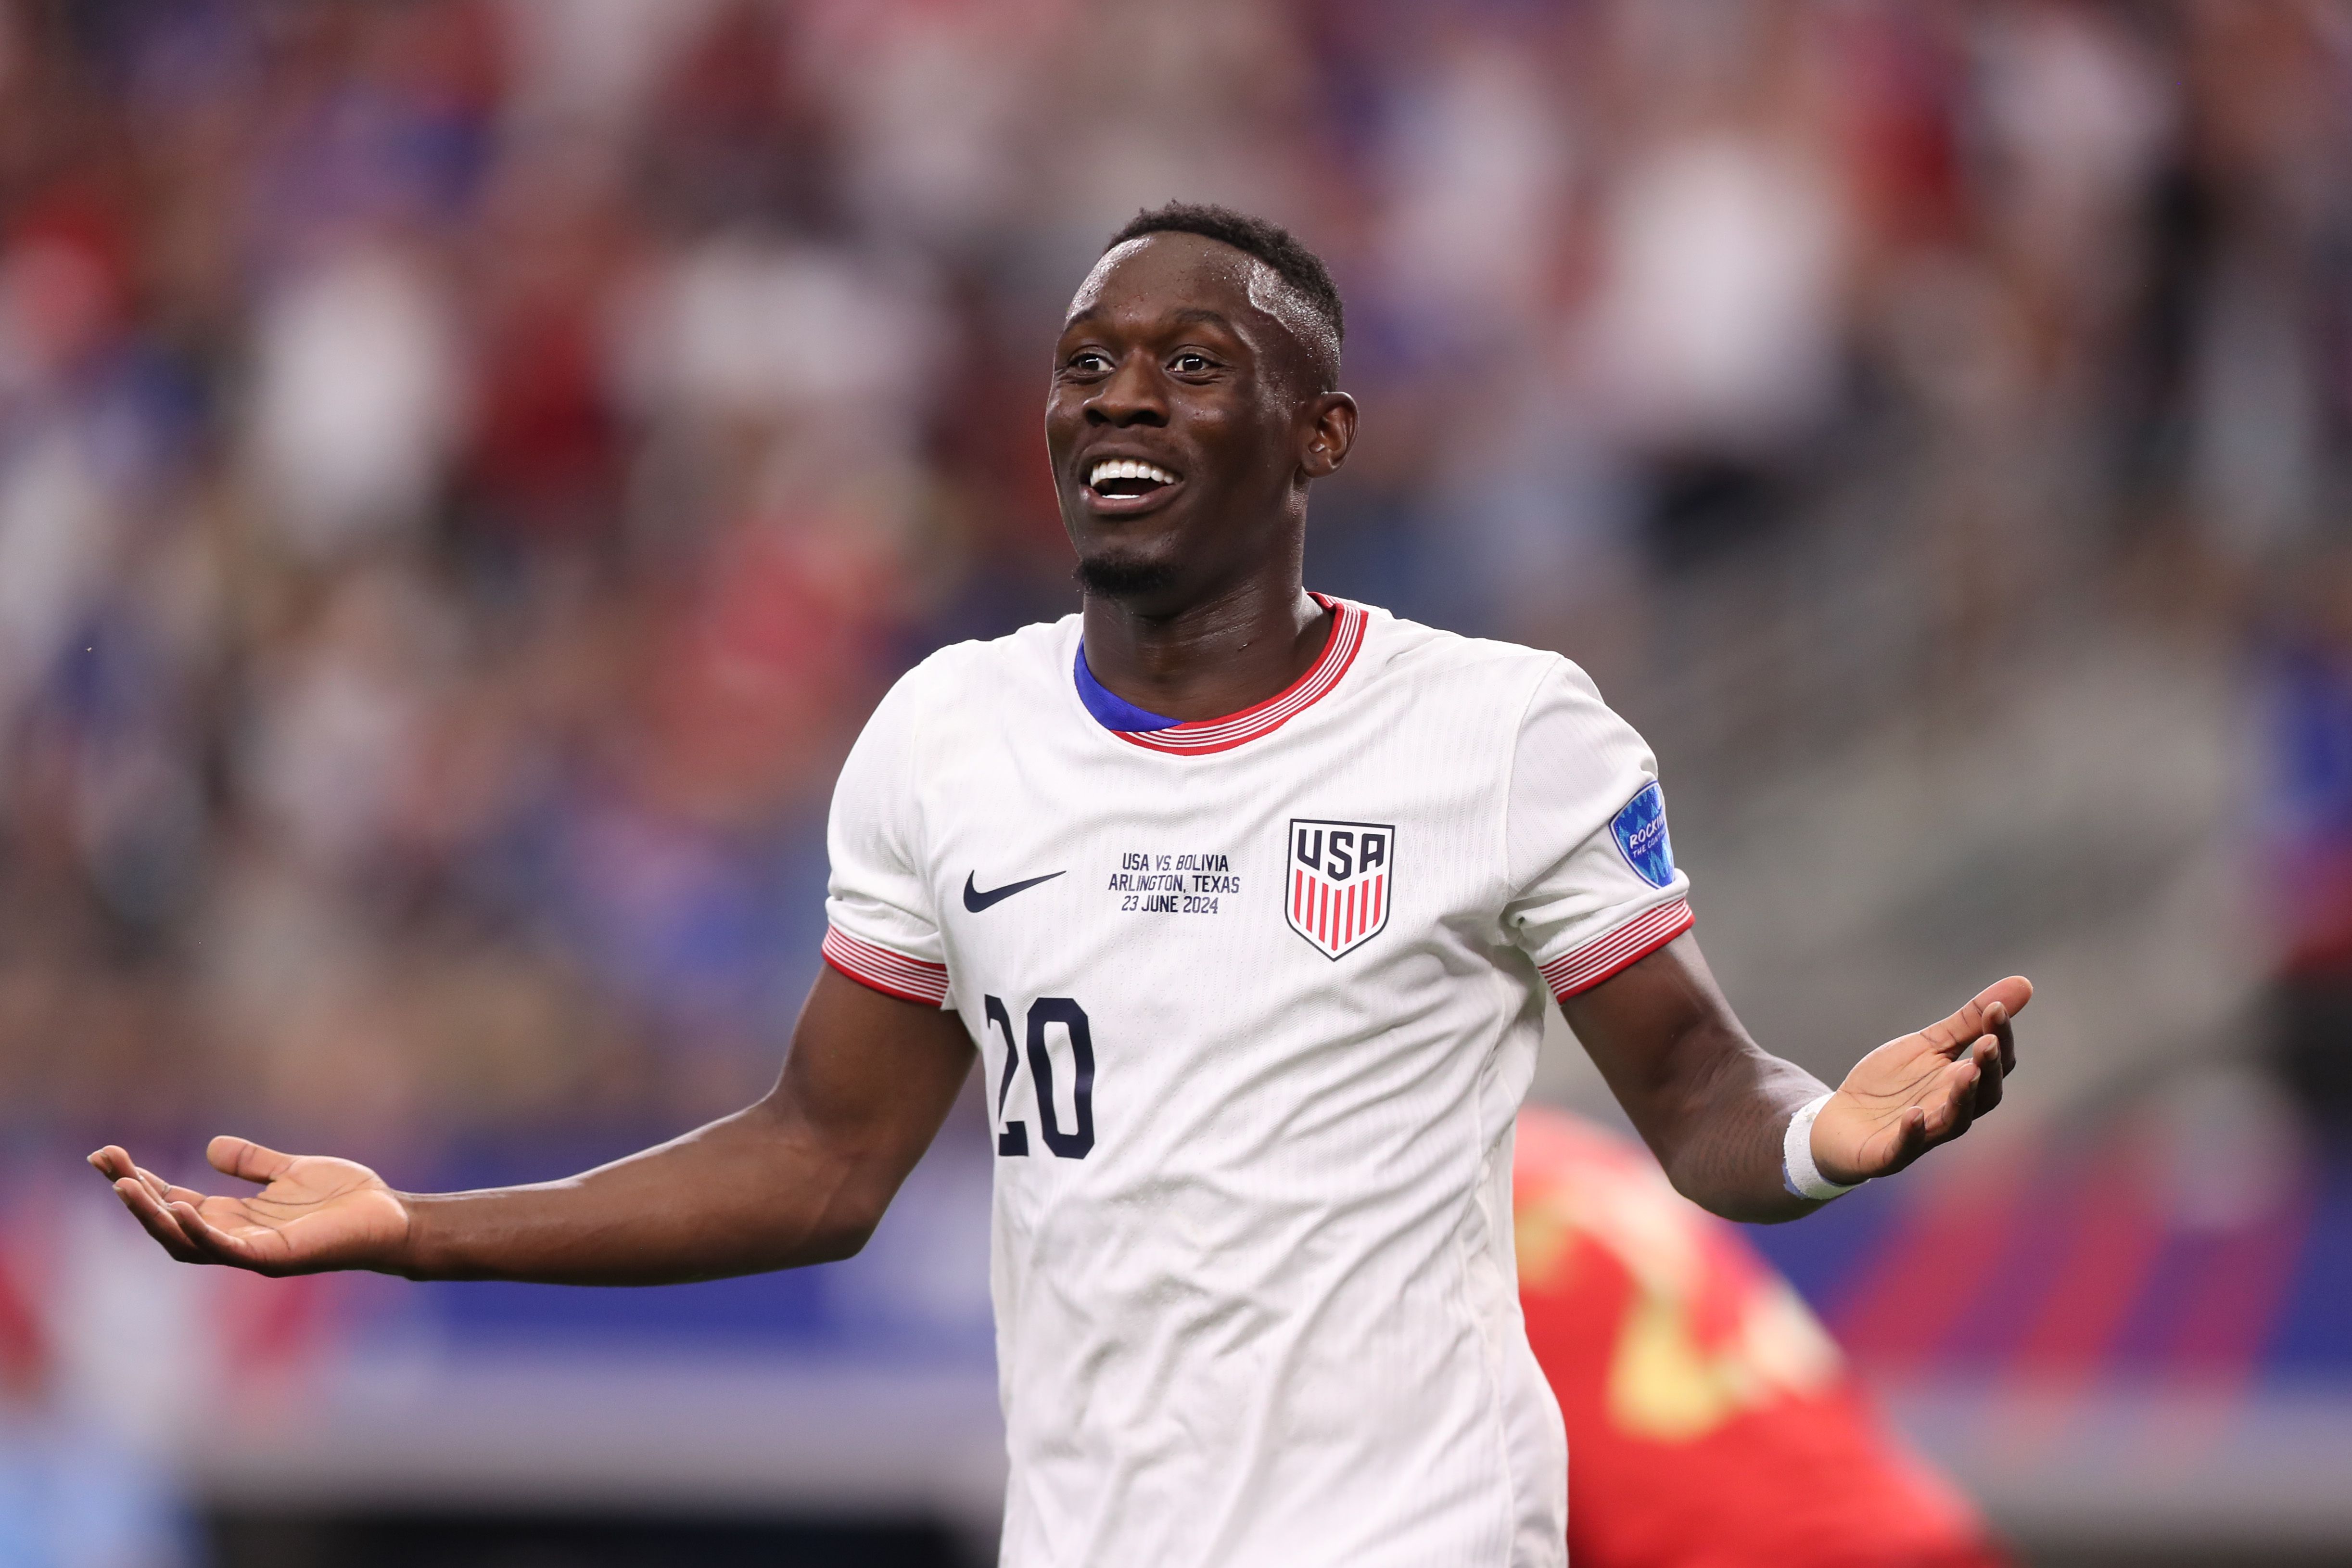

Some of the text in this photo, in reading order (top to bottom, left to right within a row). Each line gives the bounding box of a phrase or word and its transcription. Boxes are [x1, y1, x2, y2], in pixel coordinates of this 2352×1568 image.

[1297, 829, 1385, 881] USA
[1632, 844, 1647, 858] THE
[1122, 853, 1229, 872] USA VS. BOLIVIA
[1108, 873, 1240, 893] ARLINGTON, TEXAS
[1121, 895, 1219, 914] 23 JUNE 2024
[984, 993, 1095, 1160] 20
